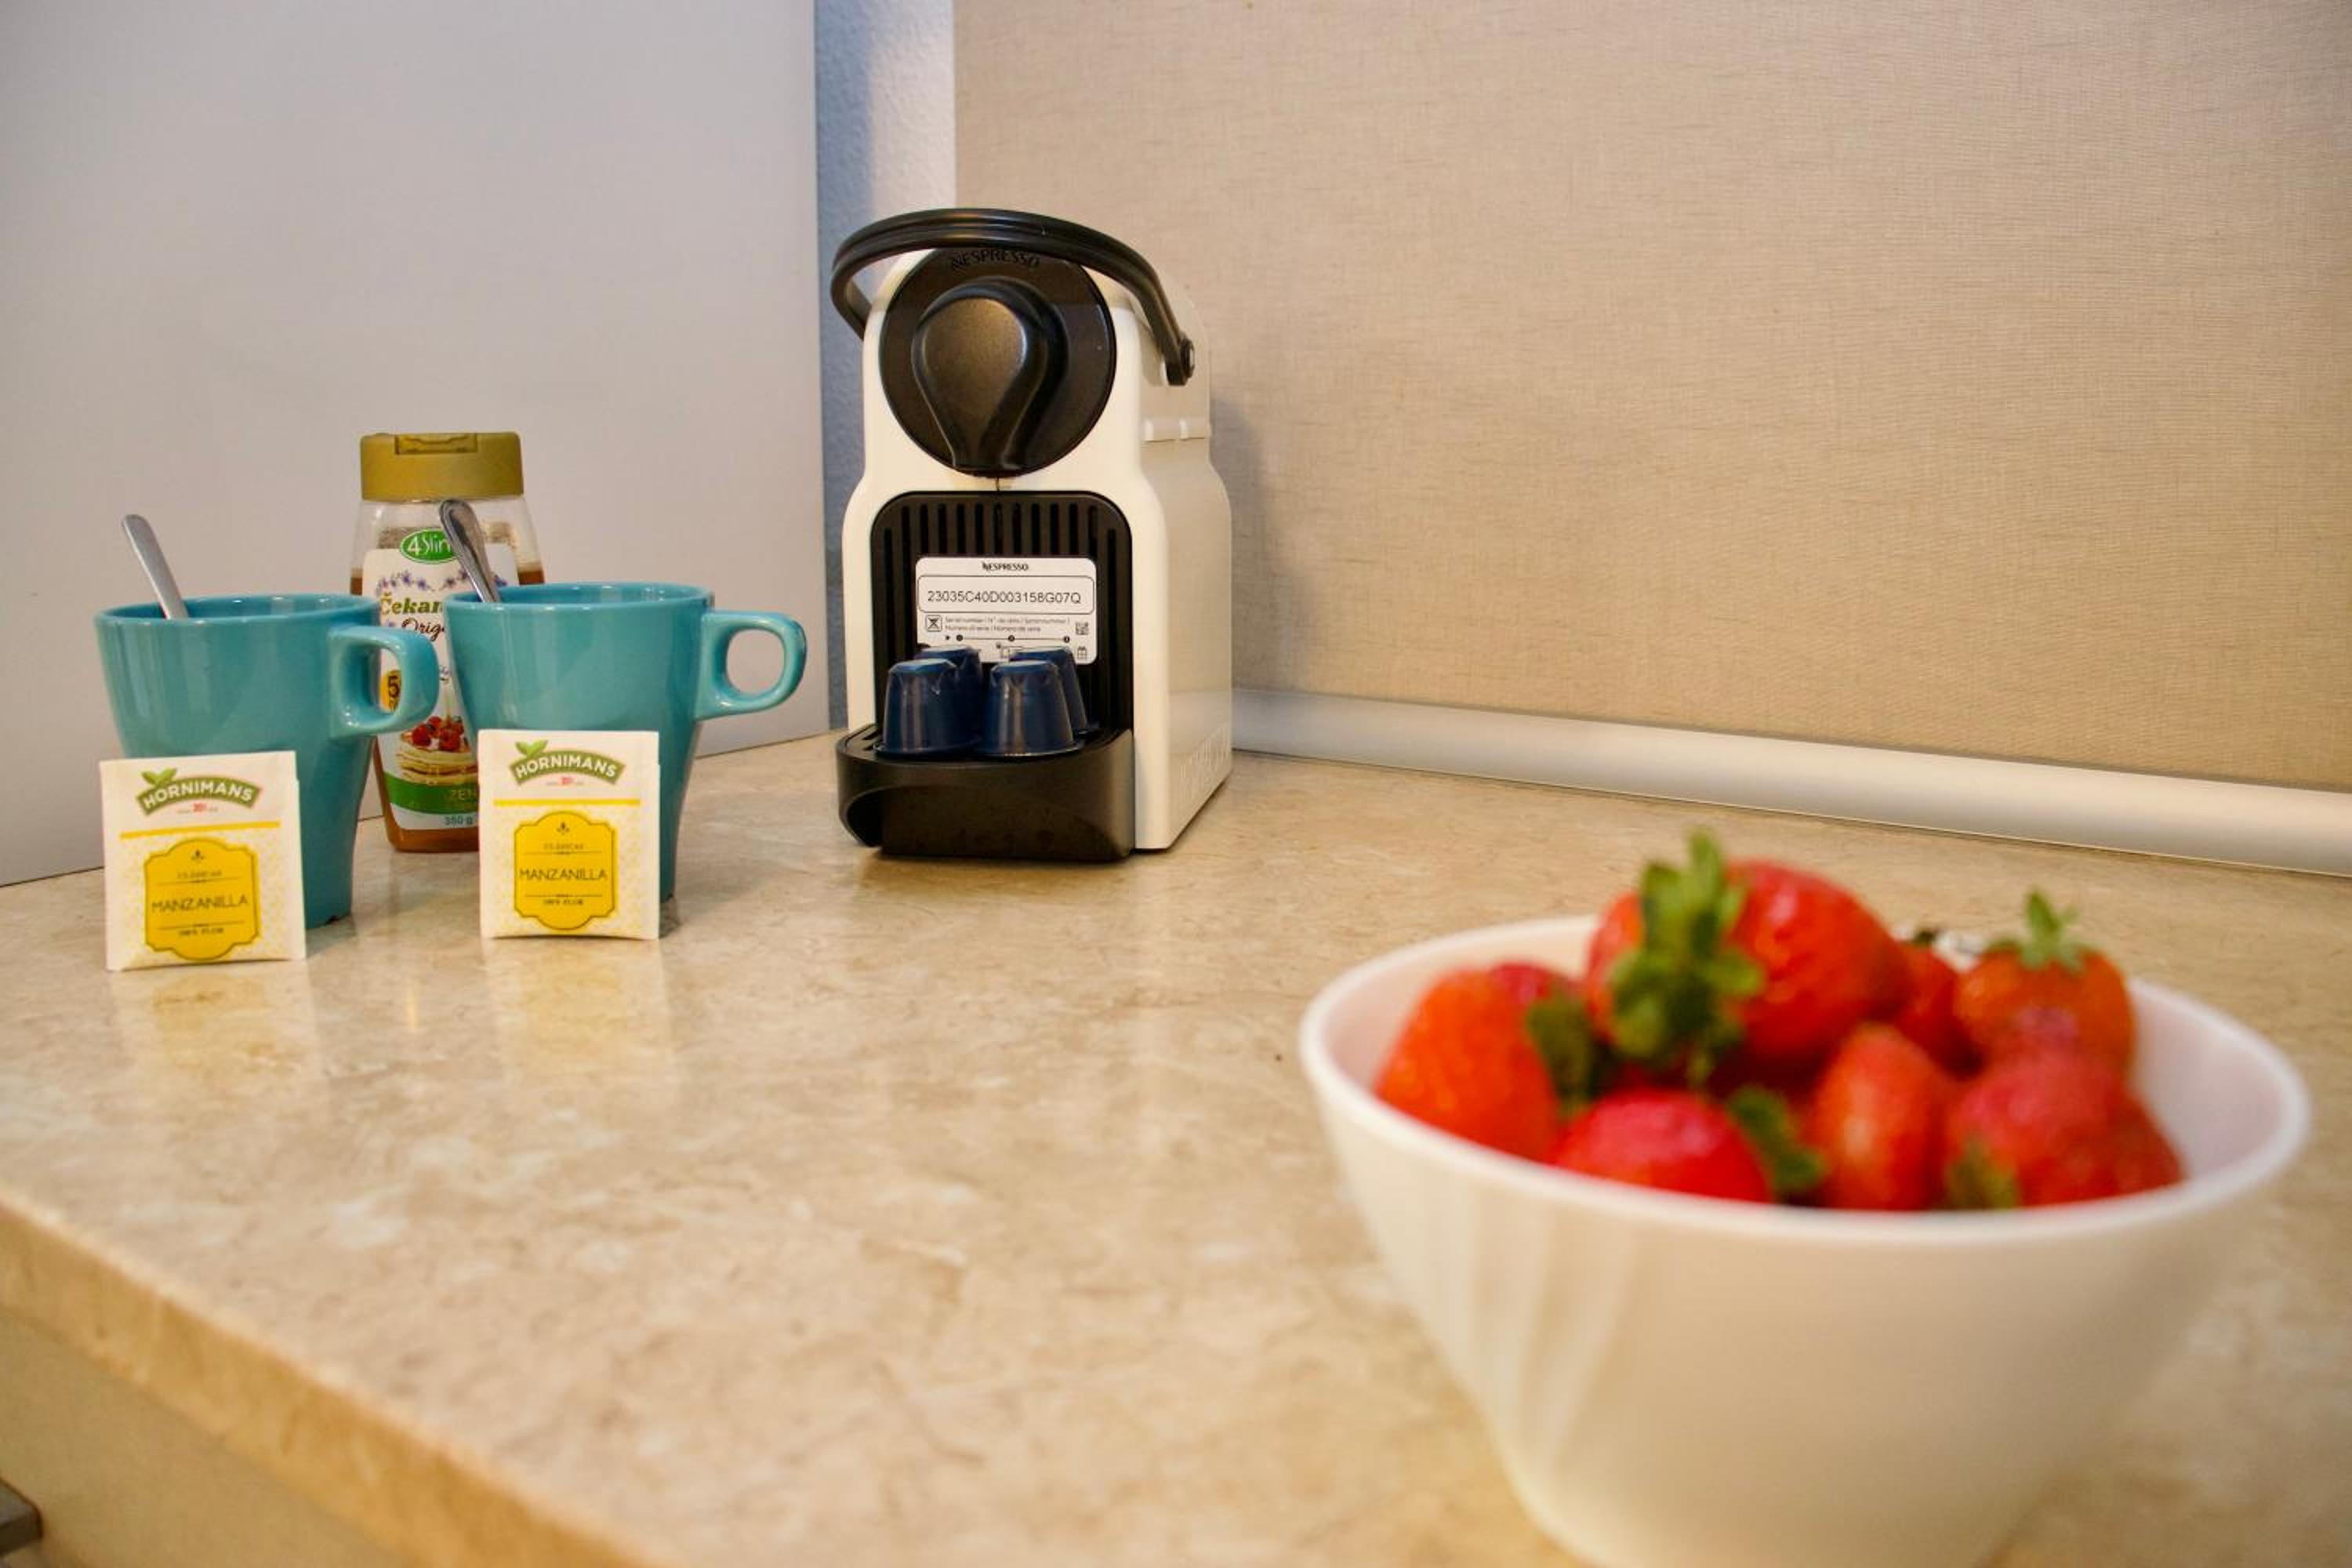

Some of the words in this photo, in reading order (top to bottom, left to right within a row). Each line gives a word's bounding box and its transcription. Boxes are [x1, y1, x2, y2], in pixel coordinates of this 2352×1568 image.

[982, 562, 1029, 572] NESPRESSO
[927, 590, 1081, 604] 23035C40D003158G07Q
[401, 617, 445, 641] Orig
[516, 754, 617, 779] HORNIMANS
[143, 781, 253, 810] HORNIMANS
[519, 868, 608, 881] MANZANILLA
[151, 893, 249, 913] MANZANILLA
